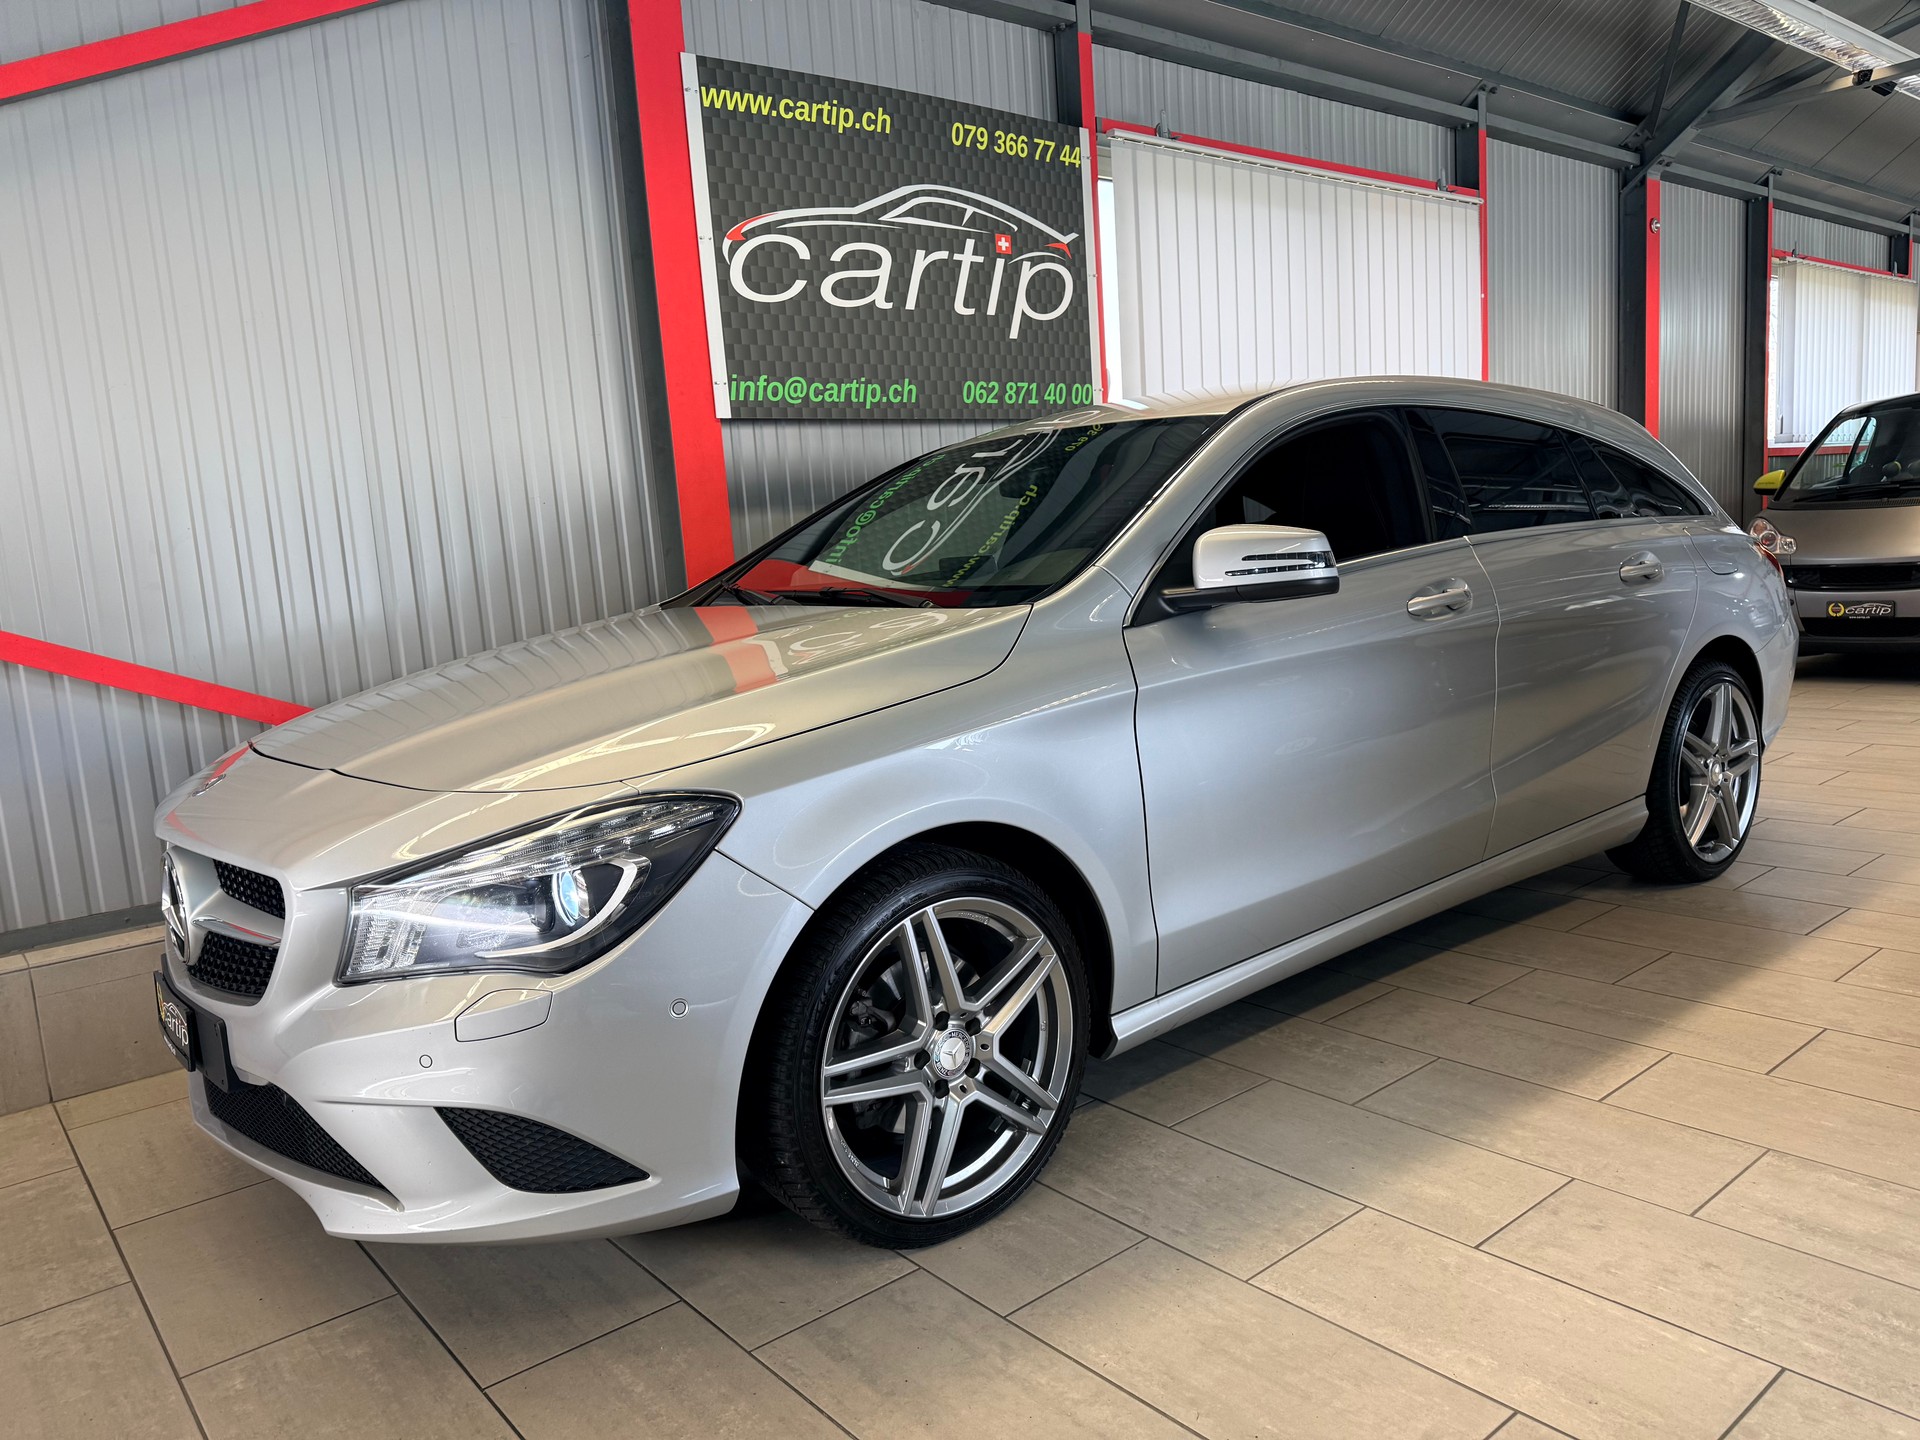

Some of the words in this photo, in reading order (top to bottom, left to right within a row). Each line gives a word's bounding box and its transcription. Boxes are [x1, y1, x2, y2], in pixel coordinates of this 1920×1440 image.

[700, 85, 891, 135] www.cartip.ch
[951, 121, 988, 150] 079
[993, 130, 1028, 158] 366
[1033, 137, 1056, 163] 77
[1059, 144, 1082, 168] 44
[729, 233, 1074, 340] cartip
[730, 373, 917, 410] info@cartip.ch
[962, 380, 999, 405] 062
[1004, 381, 1039, 405] 871
[1043, 383, 1067, 405] 40
[1071, 383, 1094, 405] 00
[1845, 605, 1891, 616] cartip
[165, 1012, 189, 1046] artip
